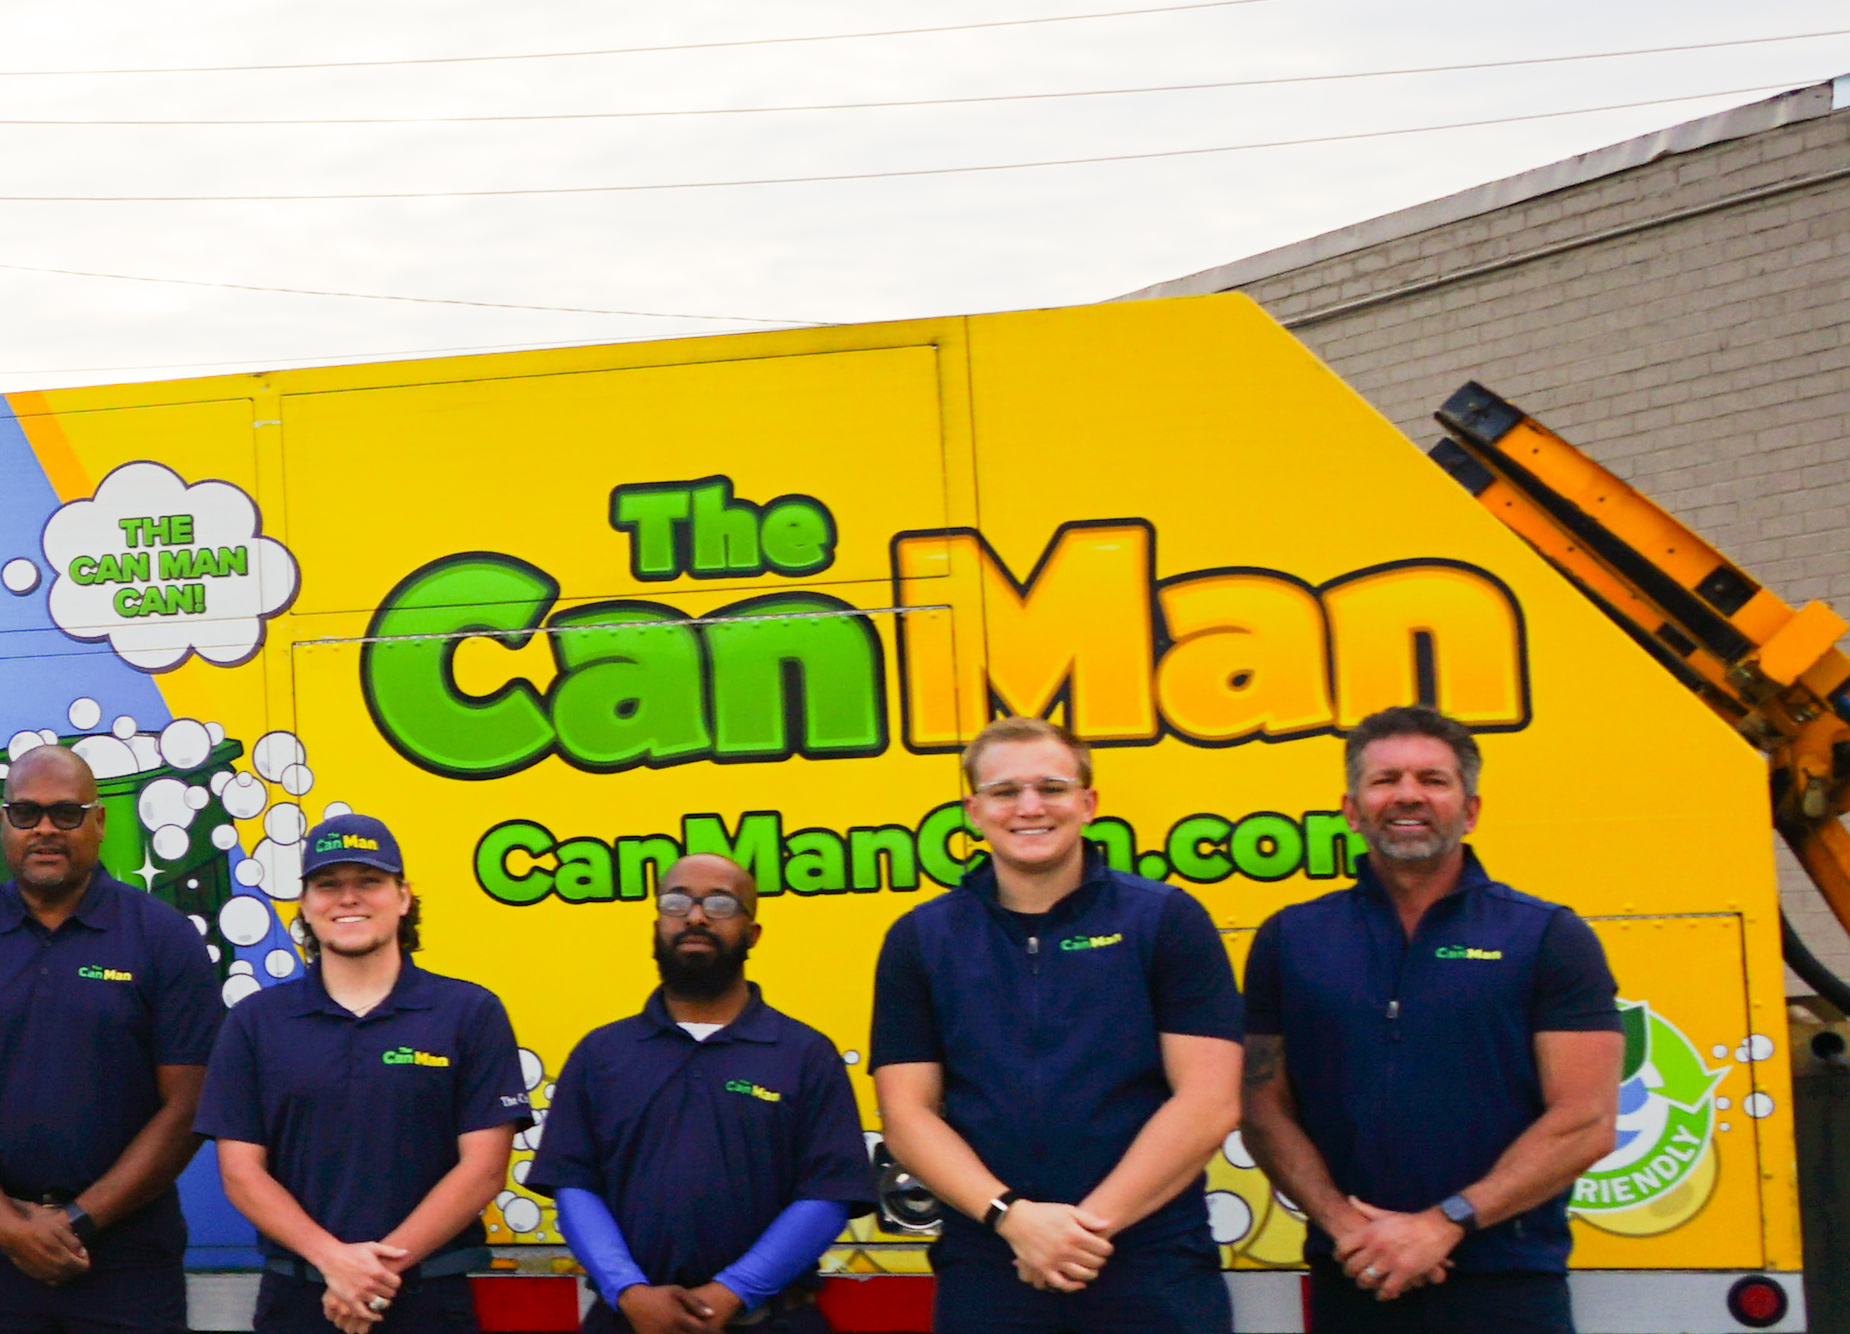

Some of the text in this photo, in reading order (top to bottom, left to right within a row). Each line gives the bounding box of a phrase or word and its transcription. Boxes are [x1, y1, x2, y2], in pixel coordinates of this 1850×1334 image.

[118, 514, 193, 548] THE
[609, 475, 836, 581] The
[69, 546, 246, 585] CAN MAN
[112, 583, 205, 617] CAN!
[1575, 1128, 1702, 1204] RIENDLY
